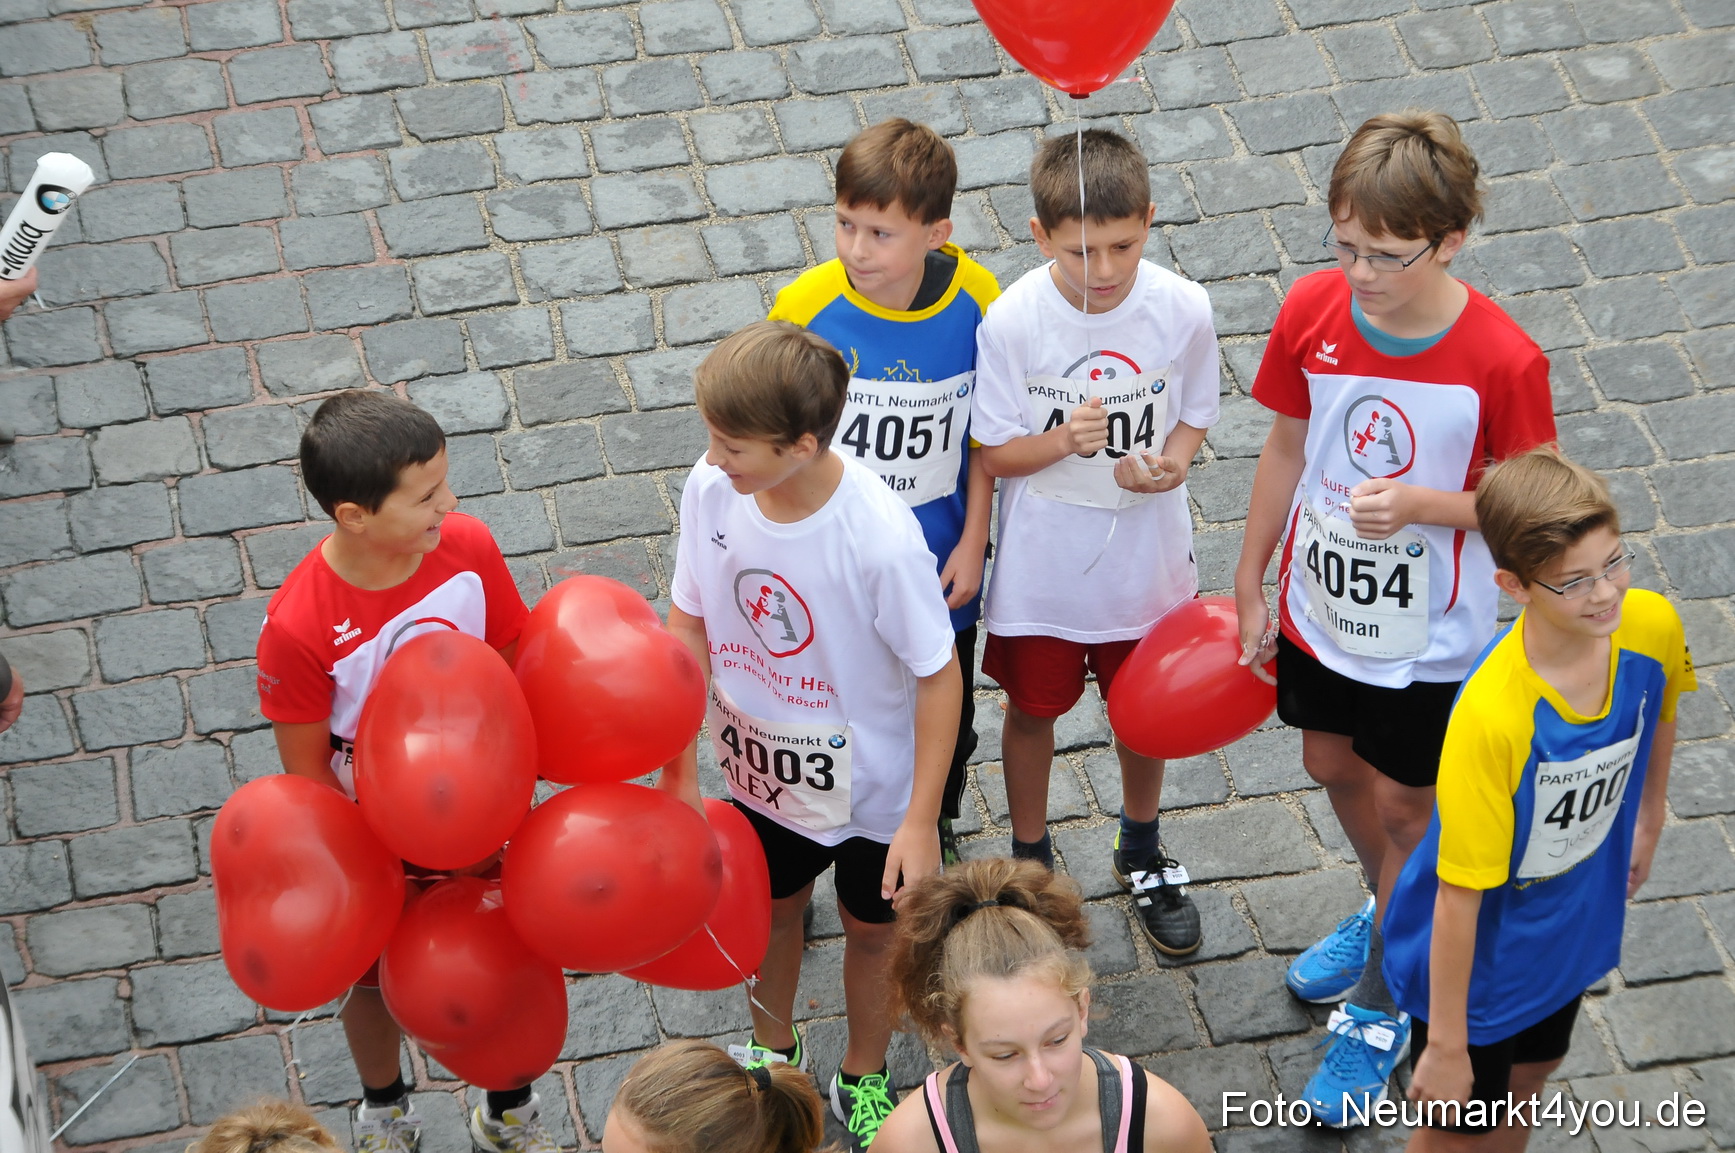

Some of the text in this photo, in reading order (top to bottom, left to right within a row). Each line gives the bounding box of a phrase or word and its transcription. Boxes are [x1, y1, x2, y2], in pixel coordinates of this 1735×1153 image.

[0, 220, 53, 280] bmw-
[1315, 351, 1338, 366] erima
[846, 391, 884, 407] ARTL
[889, 391, 953, 408] Neumarkt
[1028, 386, 1147, 406] PARTL Numarkt
[841, 406, 954, 461] 4051
[1043, 402, 1155, 459] 04
[880, 474, 918, 491] Max
[1321, 470, 1350, 497] LAUFE
[1329, 531, 1399, 555] Neumarkt
[1306, 539, 1413, 608] 4054
[333, 627, 362, 646] erima
[1324, 602, 1379, 638] Tilman
[708, 641, 764, 668] LAUFEN
[768, 666, 793, 687] MIT
[723, 659, 741, 669] Dr.
[744, 663, 767, 685] Heck
[787, 695, 829, 709] Röschl
[711, 691, 746, 730] PARTL
[749, 724, 822, 747] Neumarkt
[720, 723, 835, 792] 4003
[1539, 747, 1637, 786] PARTL Neum
[720, 756, 784, 810] ALEX
[1544, 762, 1630, 830] 400
